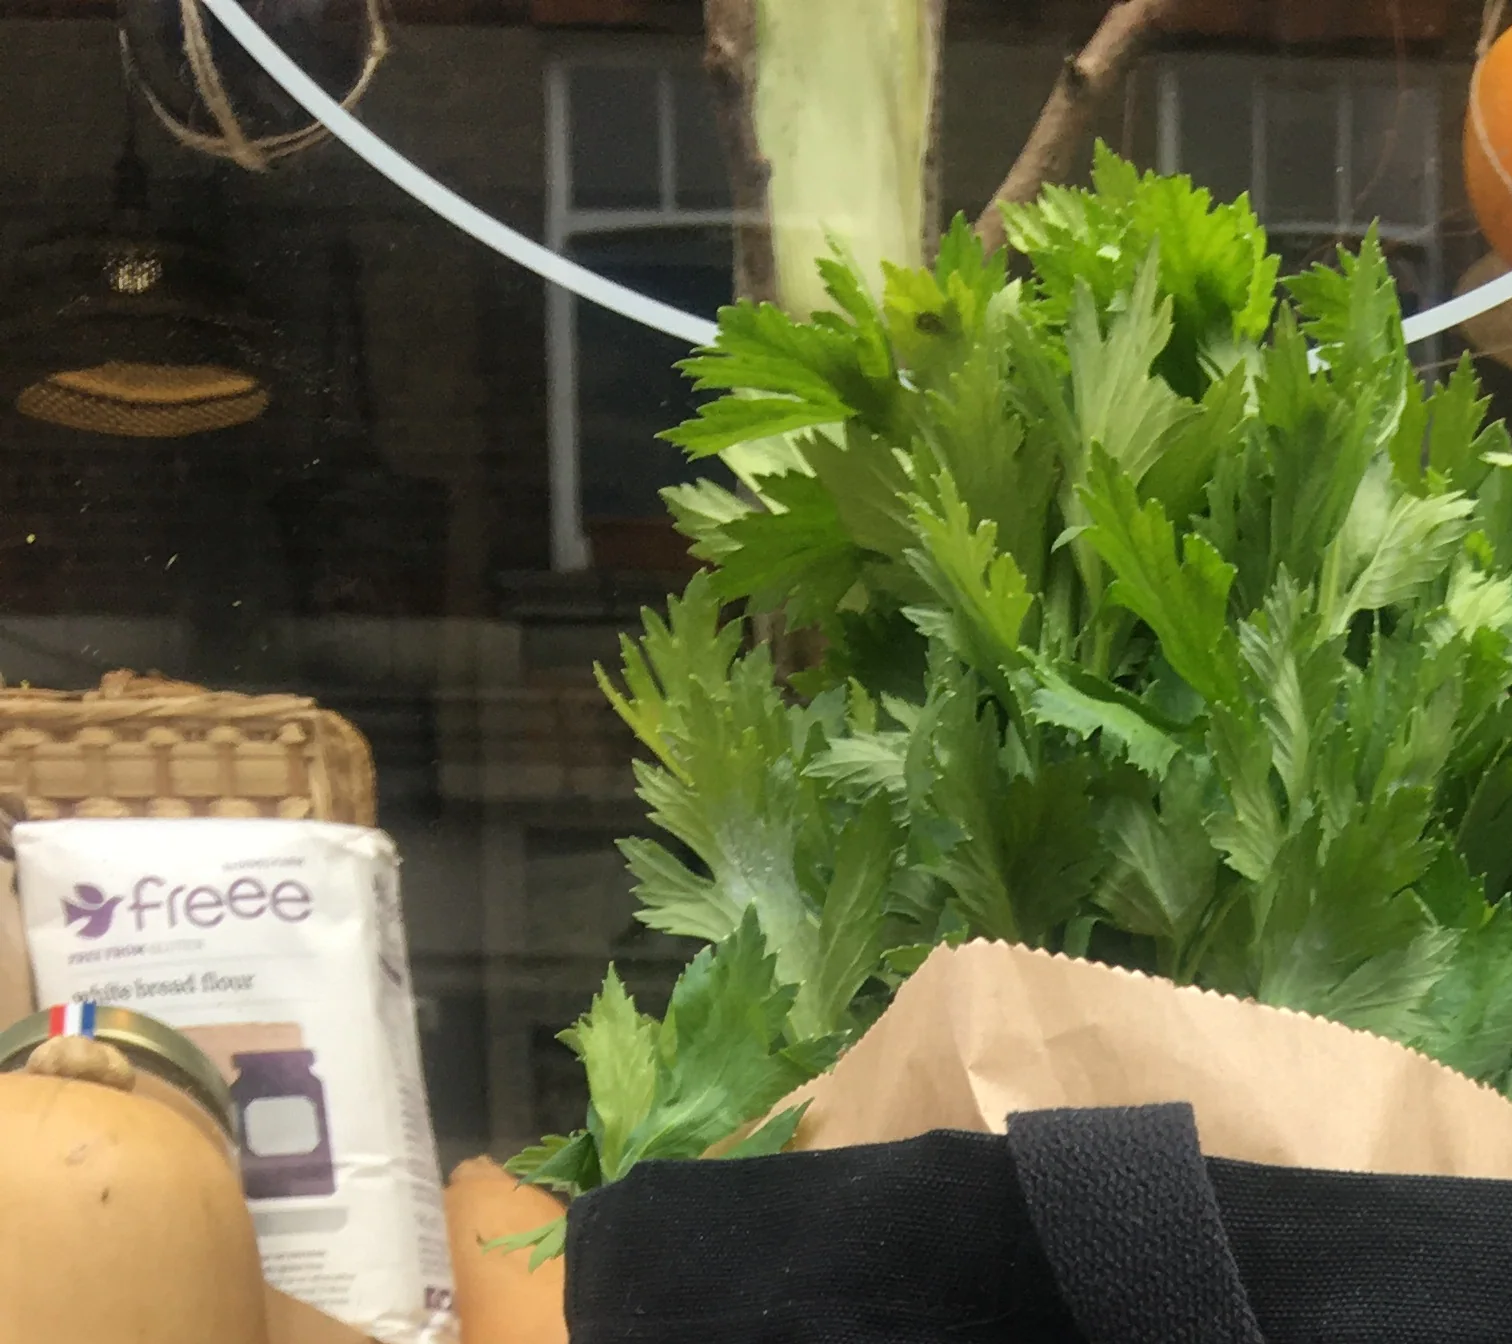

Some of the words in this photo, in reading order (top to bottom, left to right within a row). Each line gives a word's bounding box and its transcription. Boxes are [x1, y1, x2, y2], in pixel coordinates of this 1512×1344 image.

[128, 874, 314, 932] freee
[134, 974, 197, 998] bread
[201, 970, 255, 992] flour
